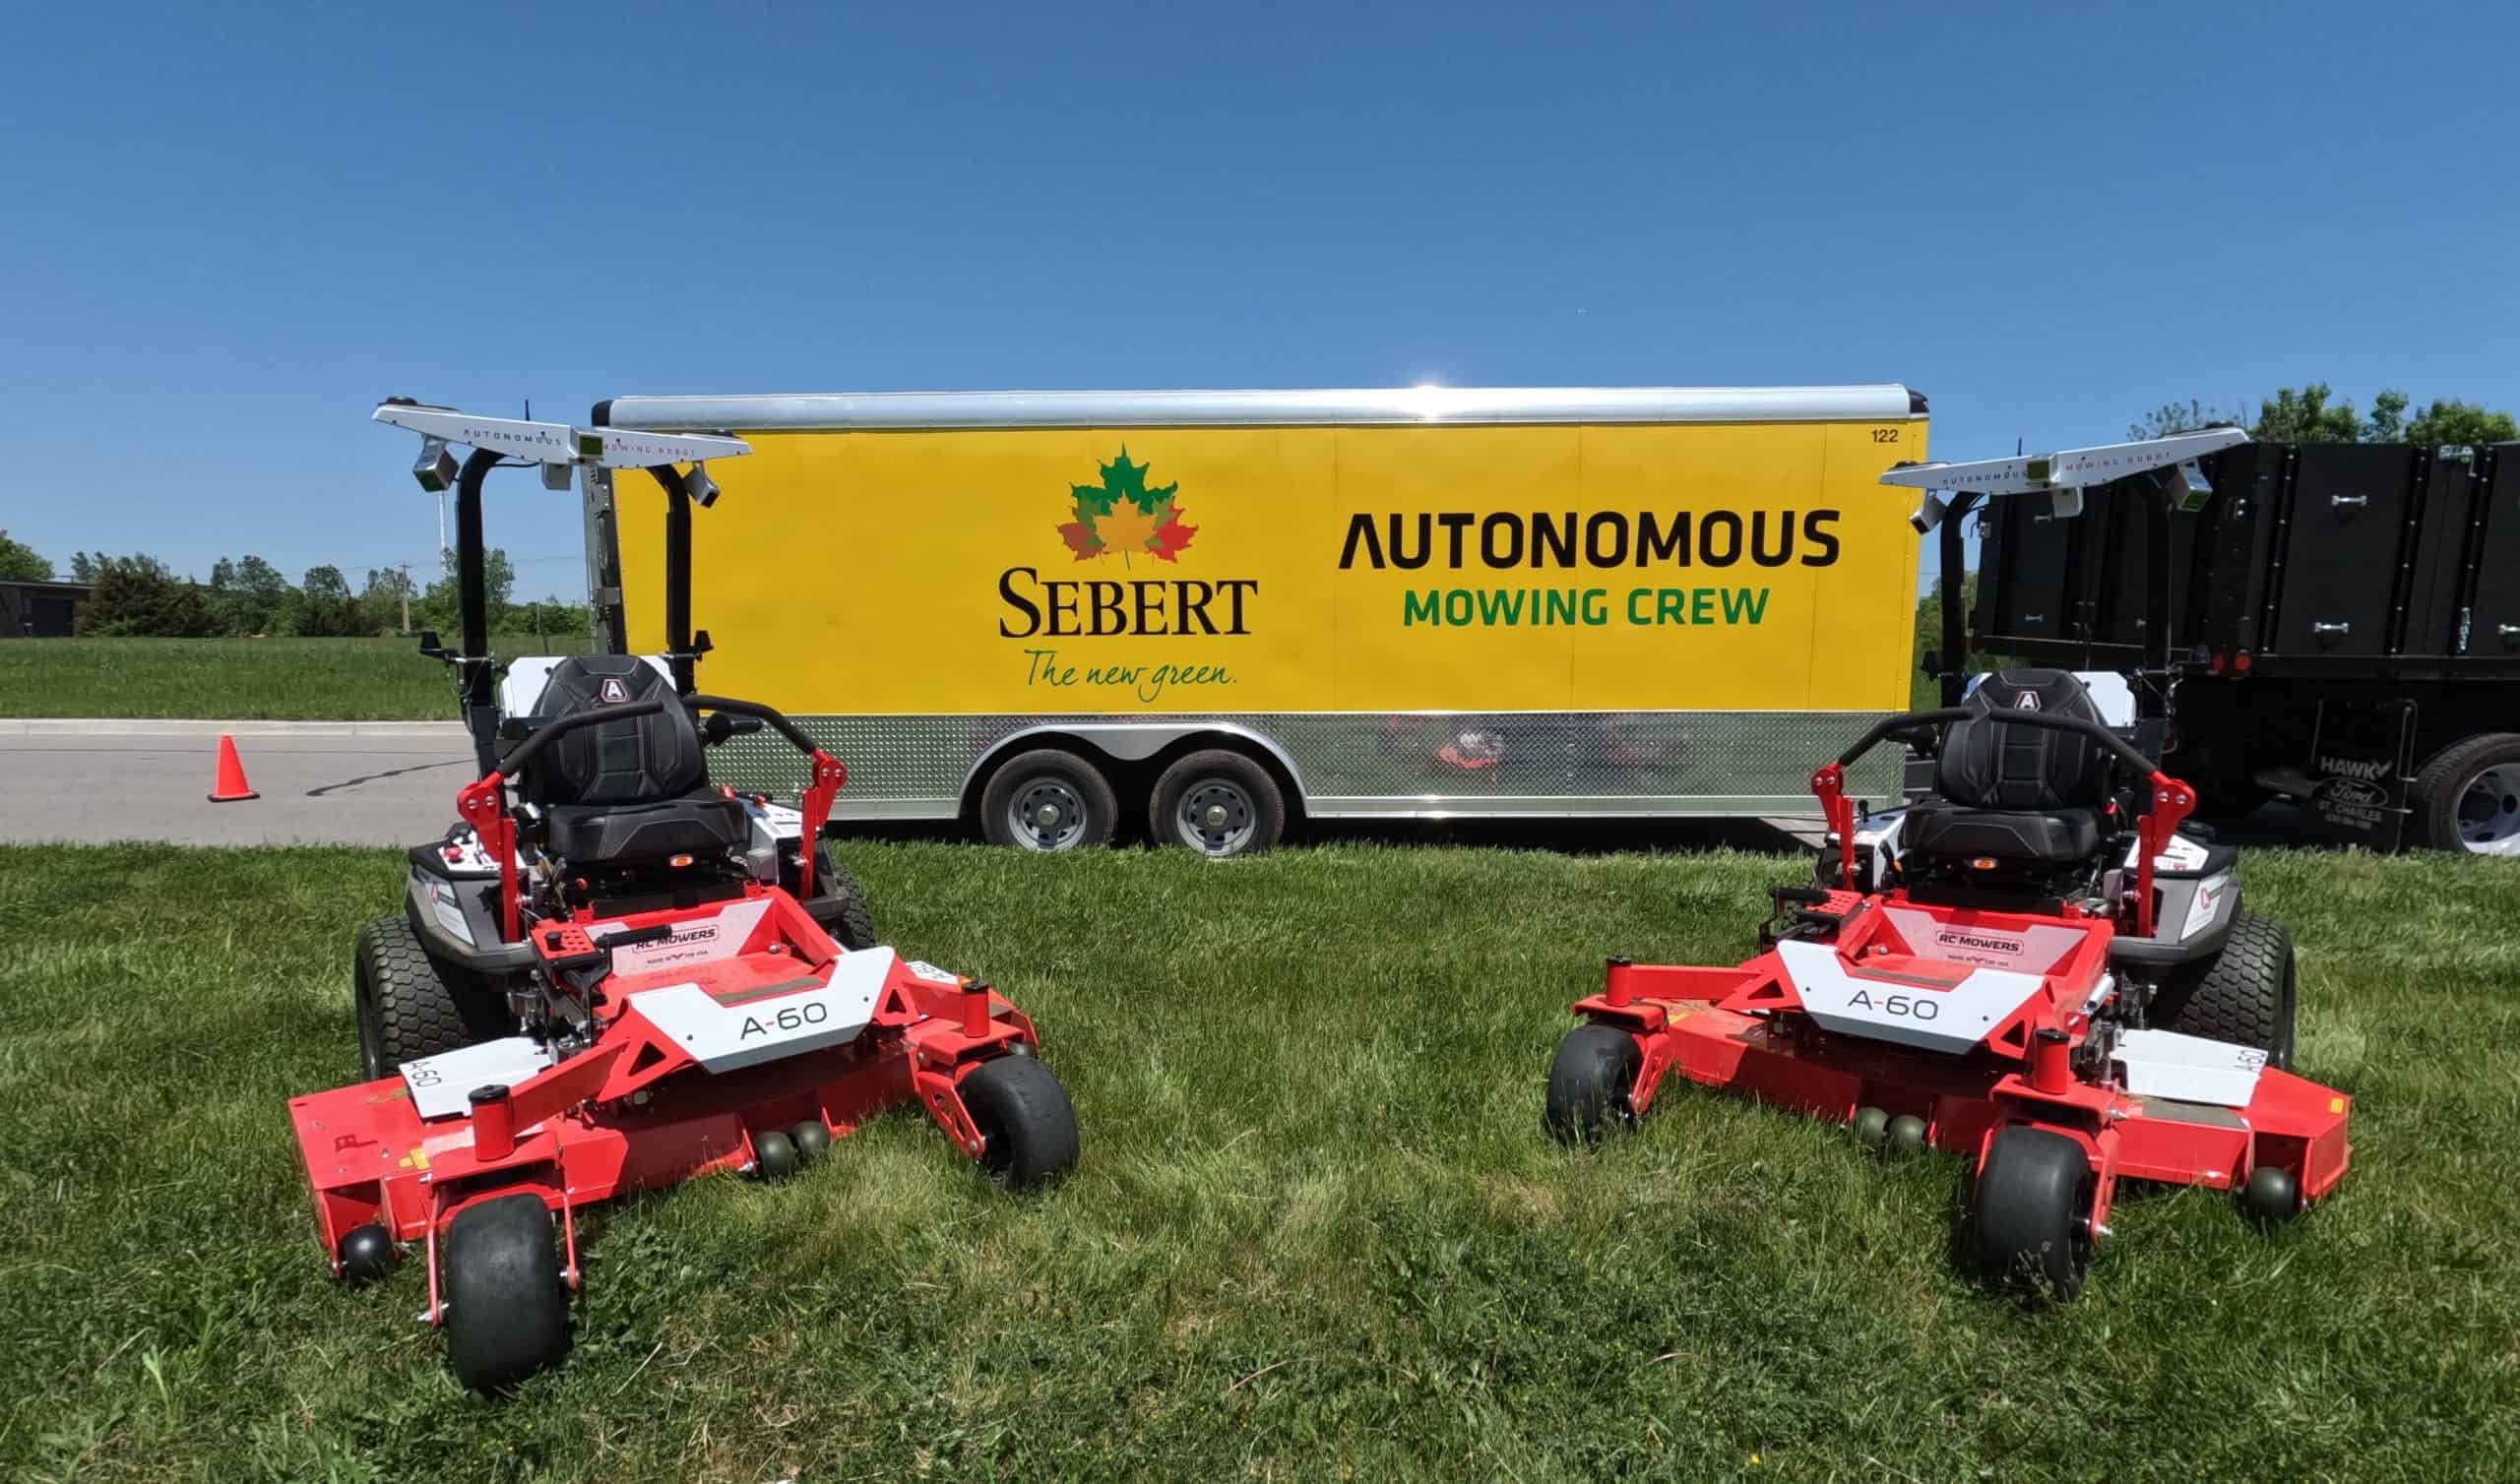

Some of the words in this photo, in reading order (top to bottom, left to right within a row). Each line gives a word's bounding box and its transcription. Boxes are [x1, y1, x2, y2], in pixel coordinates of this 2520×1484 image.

[462, 428, 562, 447] AUTONOMOUS
[1871, 429, 1899, 443] 122
[1339, 510, 1841, 570] AUTONOMOUS
[998, 567, 1259, 638] SEBERT
[1403, 588, 1608, 627] MOWING
[1627, 587, 1771, 626] CREW
[1023, 649, 1080, 686] The
[1086, 665, 1150, 686] new
[1138, 663, 1237, 703] green.
[657, 928, 717, 946] MOWERS
[1938, 934, 1958, 944] RC
[1959, 936, 2020, 952] MOWERS
[740, 1002, 828, 1040] A-60
[1847, 990, 1938, 1020] A-60
